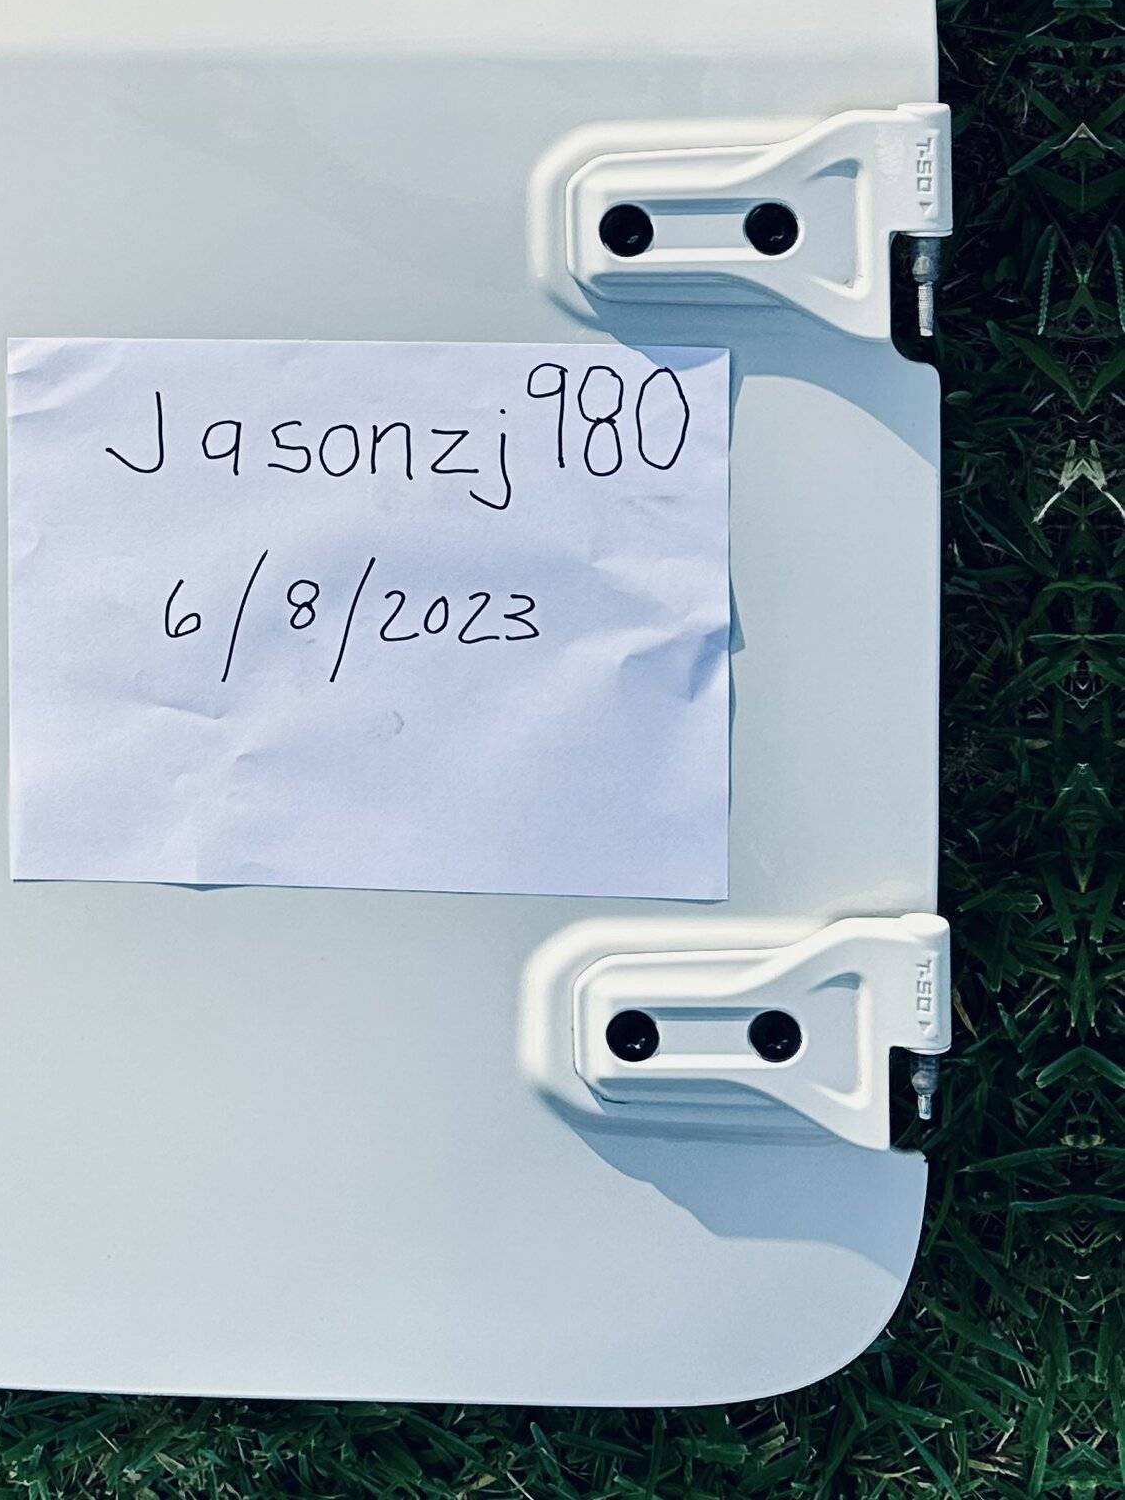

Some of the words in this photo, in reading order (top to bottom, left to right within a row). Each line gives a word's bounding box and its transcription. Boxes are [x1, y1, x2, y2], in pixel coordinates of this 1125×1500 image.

[915, 136, 933, 192] T-50
[105, 362, 690, 510] Jasonzj980
[164, 548, 540, 683] 6/8/2023
[915, 958, 933, 1012] T-50
